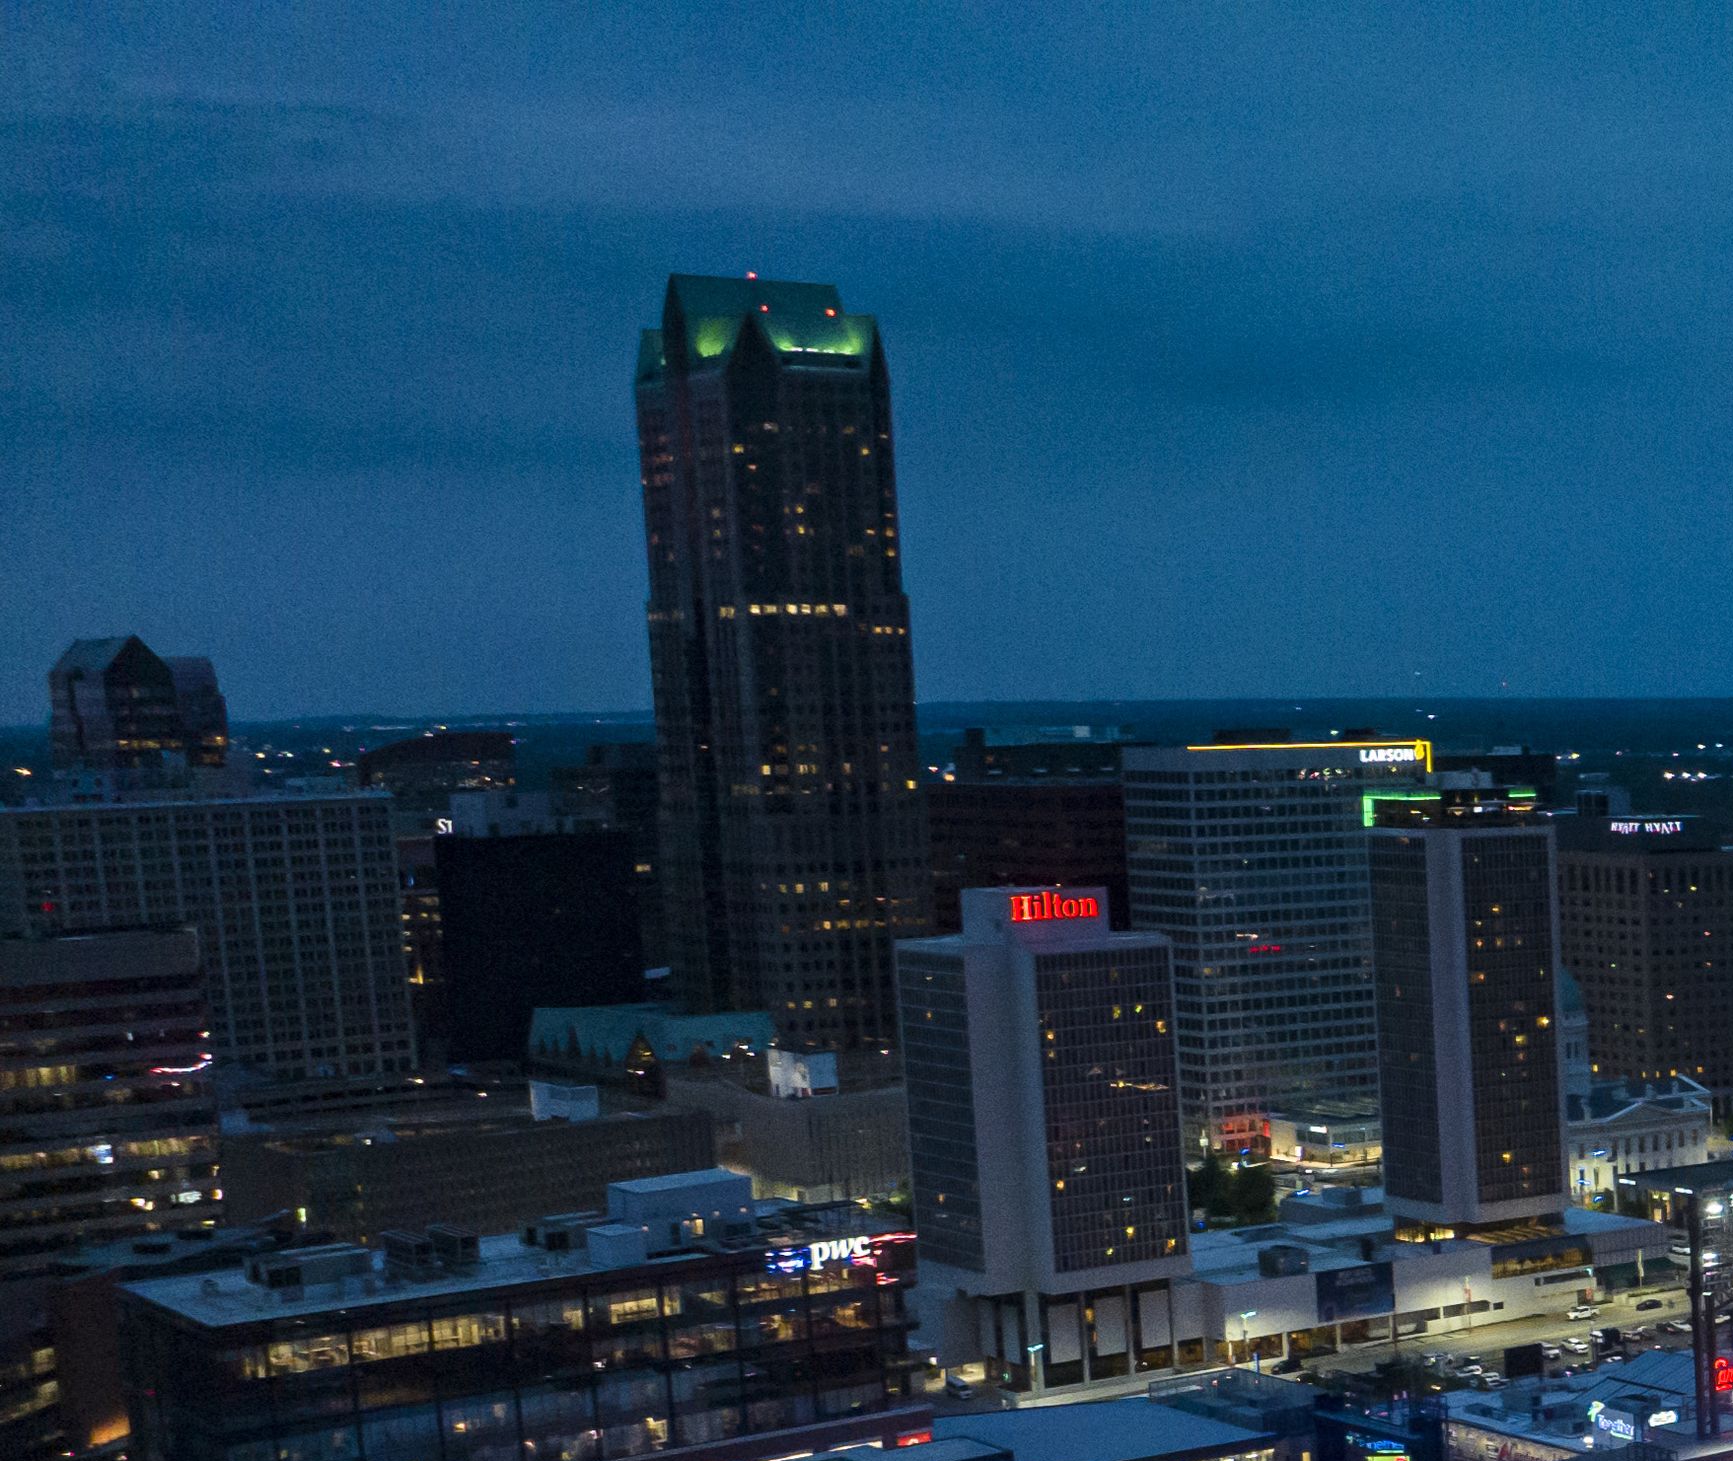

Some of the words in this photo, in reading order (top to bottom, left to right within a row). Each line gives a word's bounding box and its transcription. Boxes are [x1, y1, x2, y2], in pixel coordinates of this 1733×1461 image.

[1360, 748, 1415, 763] LARSON
[1010, 890, 1100, 921] Hilton
[808, 1236, 871, 1270] pwc
